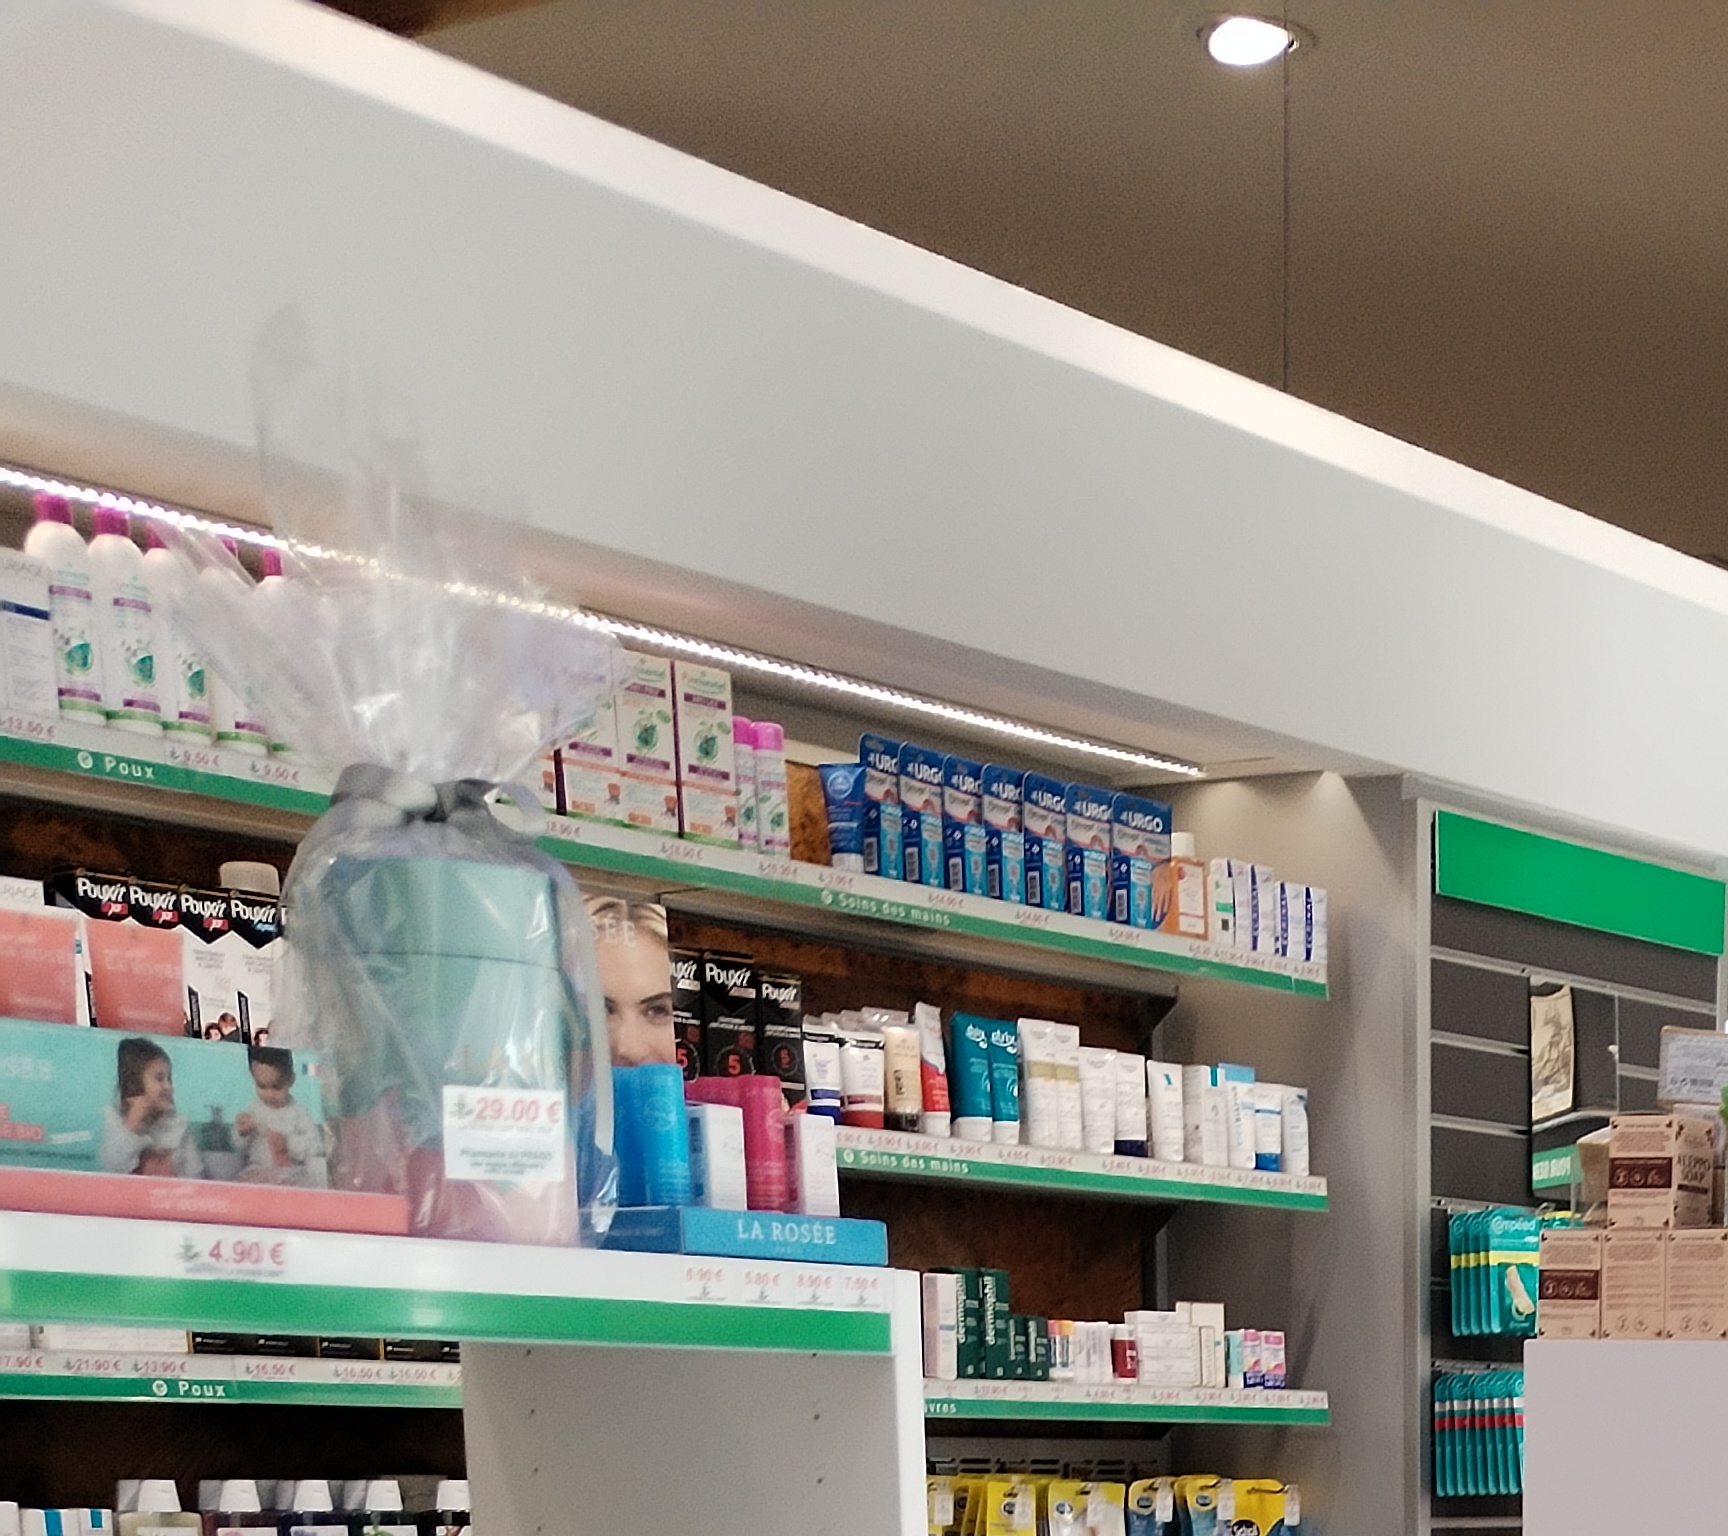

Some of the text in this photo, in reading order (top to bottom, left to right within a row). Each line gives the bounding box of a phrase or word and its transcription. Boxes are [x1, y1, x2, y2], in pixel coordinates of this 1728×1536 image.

[104, 755, 155, 779] Poux
[1128, 811, 1163, 834] URGO
[77, 878, 126, 902] Pouxit
[129, 886, 176, 909] Pouxit
[181, 894, 226, 917] Pouxit
[231, 900, 275, 923] Pouxit
[838, 892, 950, 927] Soins des mains
[705, 963, 750, 986] Pouxit
[475, 1096, 561, 1123] 29.00 €
[860, 1150, 969, 1173] Soins des mains
[737, 1220, 837, 1244] LA ROSÉE
[209, 1240, 285, 1265] 4.90 €
[178, 1381, 226, 1397] Poux
